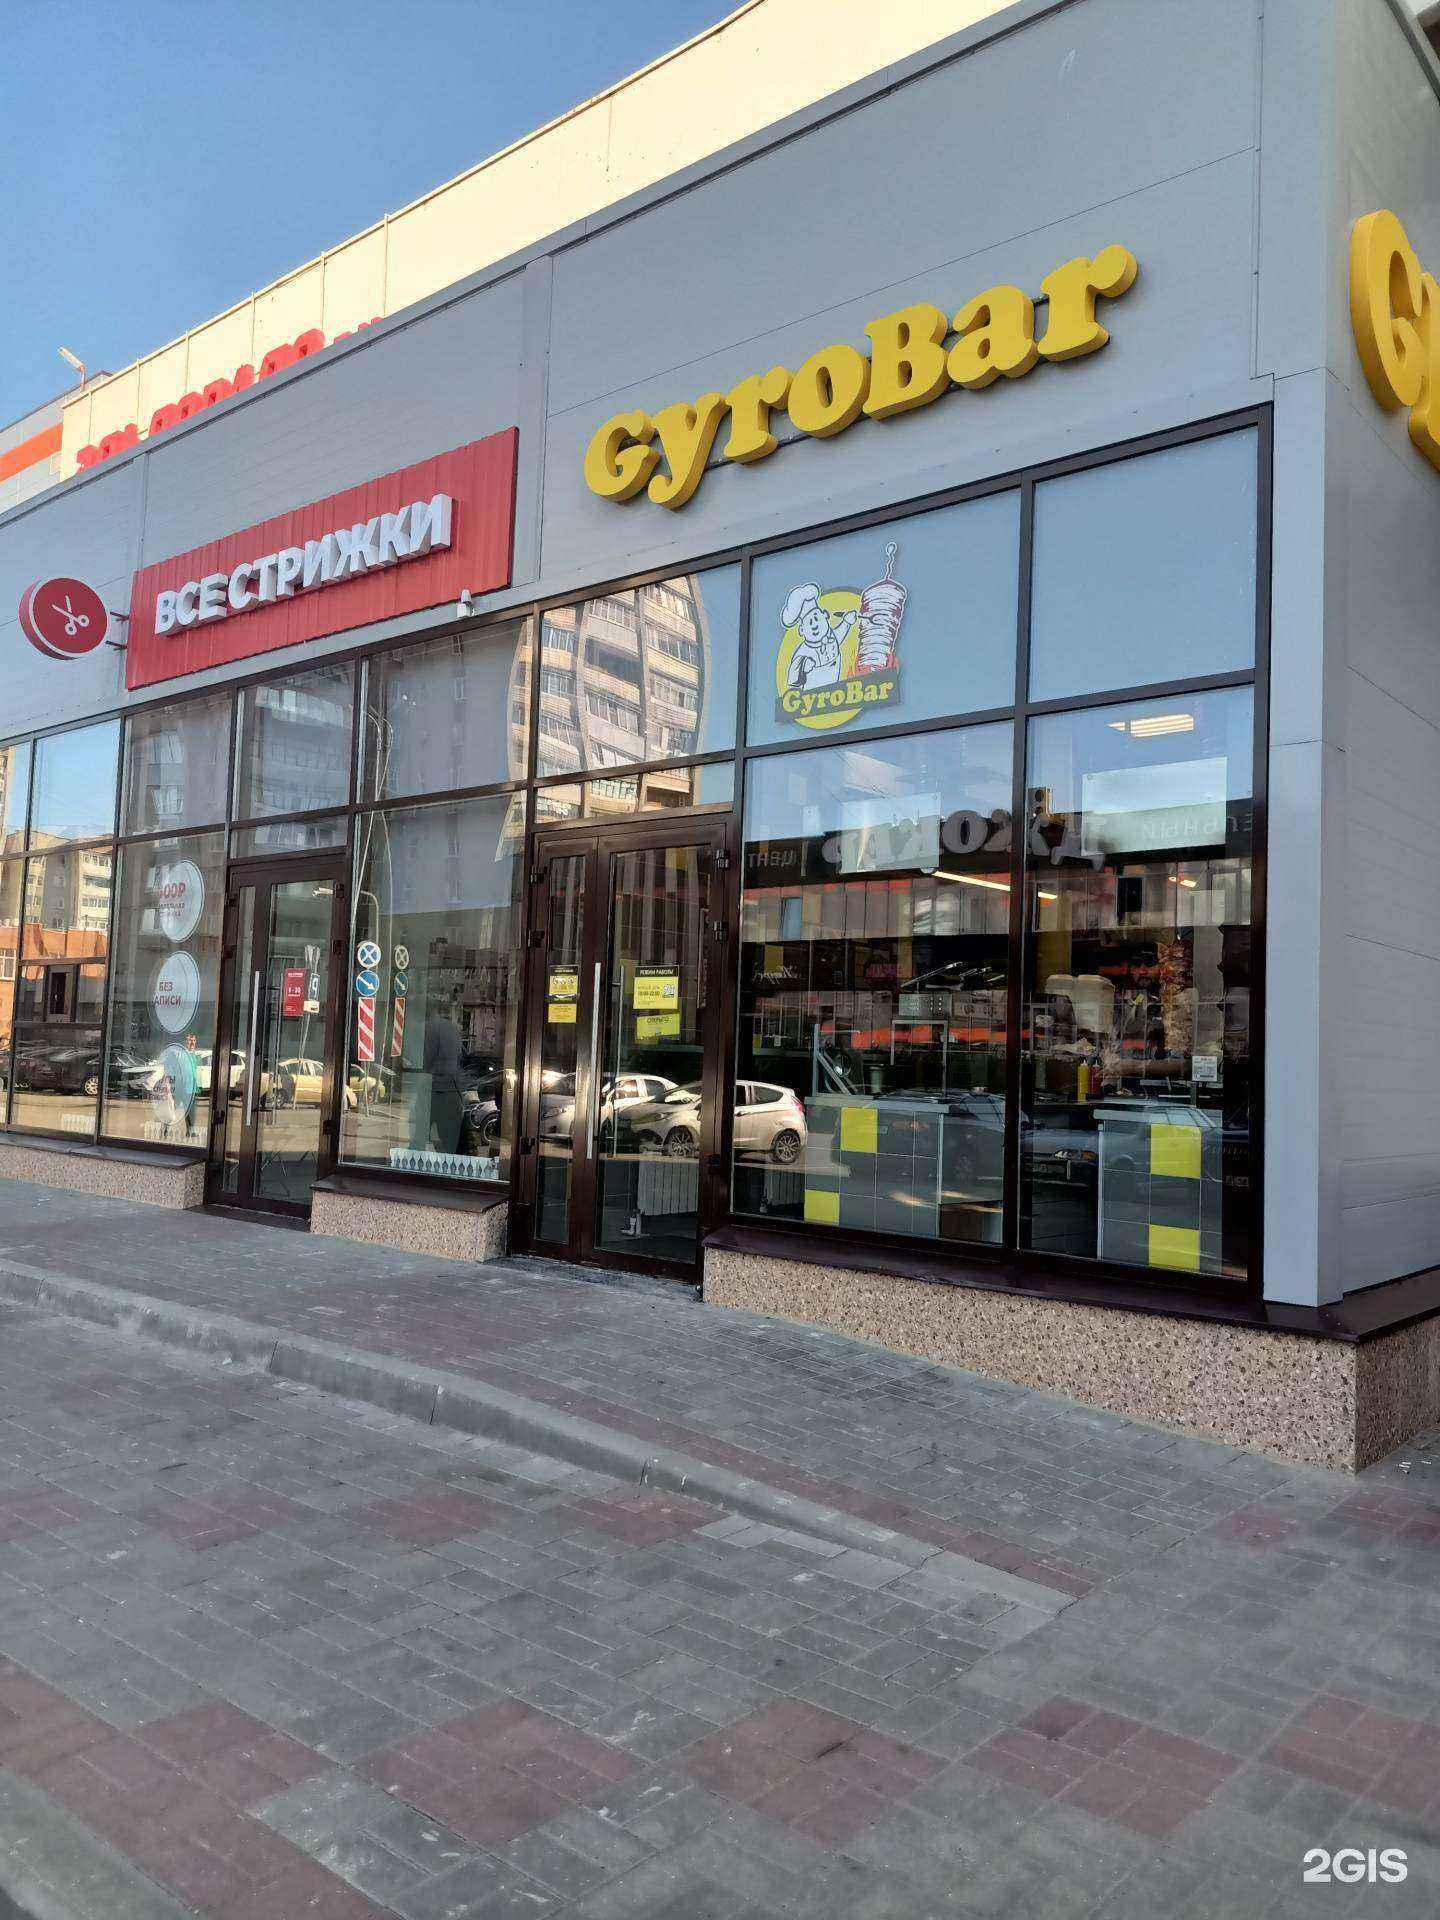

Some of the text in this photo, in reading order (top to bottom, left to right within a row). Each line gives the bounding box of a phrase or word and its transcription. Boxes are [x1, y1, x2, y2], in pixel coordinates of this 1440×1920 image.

[584, 244, 1138, 509] GyroBar
[782, 680, 893, 714] GyroBar
[153, 995, 182, 1006] АПИСИ
